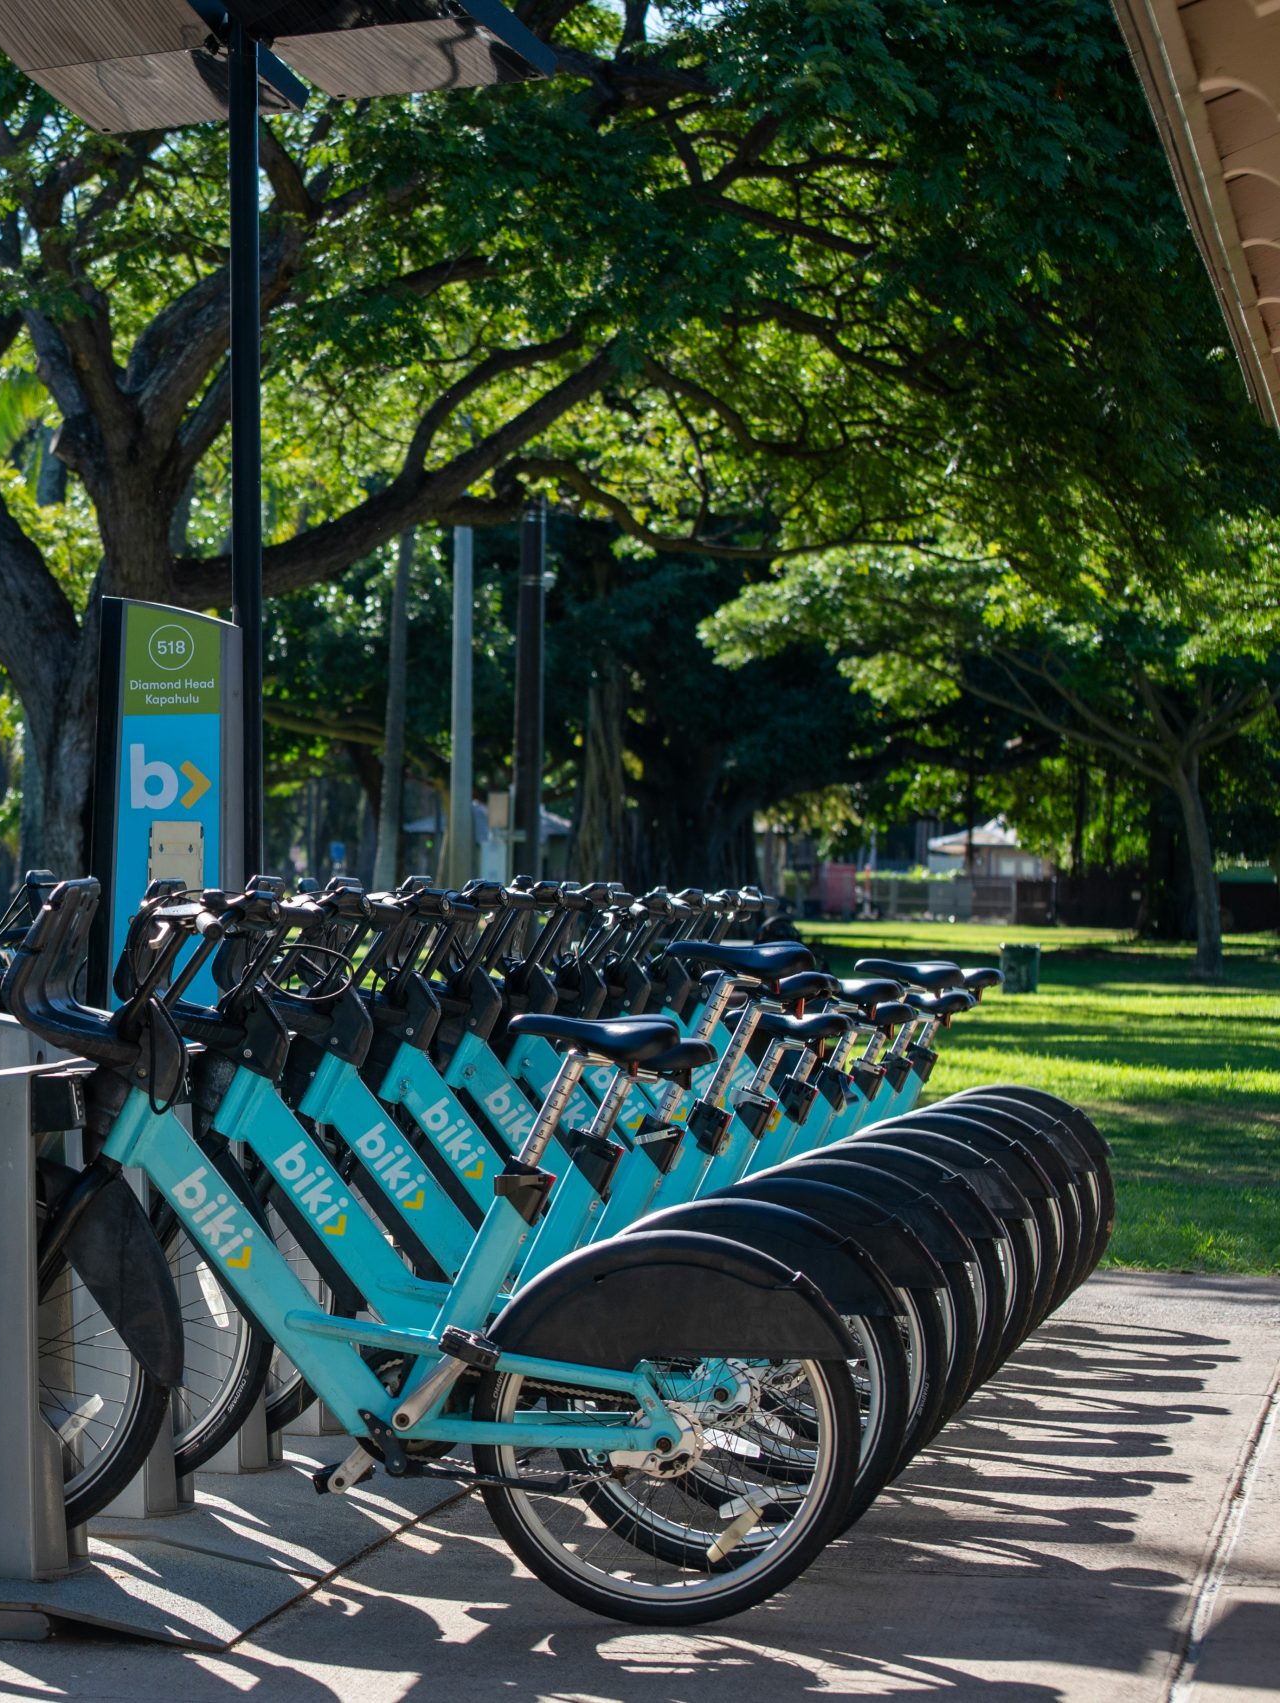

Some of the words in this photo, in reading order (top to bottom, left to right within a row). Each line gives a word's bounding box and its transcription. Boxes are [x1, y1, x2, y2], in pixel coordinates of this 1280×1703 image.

[157, 640, 186, 655] 518
[129, 679, 181, 690] Diamond
[184, 678, 215, 689] Head
[145, 693, 200, 707] Kapahulu
[130, 743, 179, 809] b
[421, 1096, 486, 1170] biki
[484, 1082, 532, 1150] bik
[273, 1140, 348, 1225] biki
[355, 1121, 426, 1200] biki
[171, 1166, 253, 1257] biki
